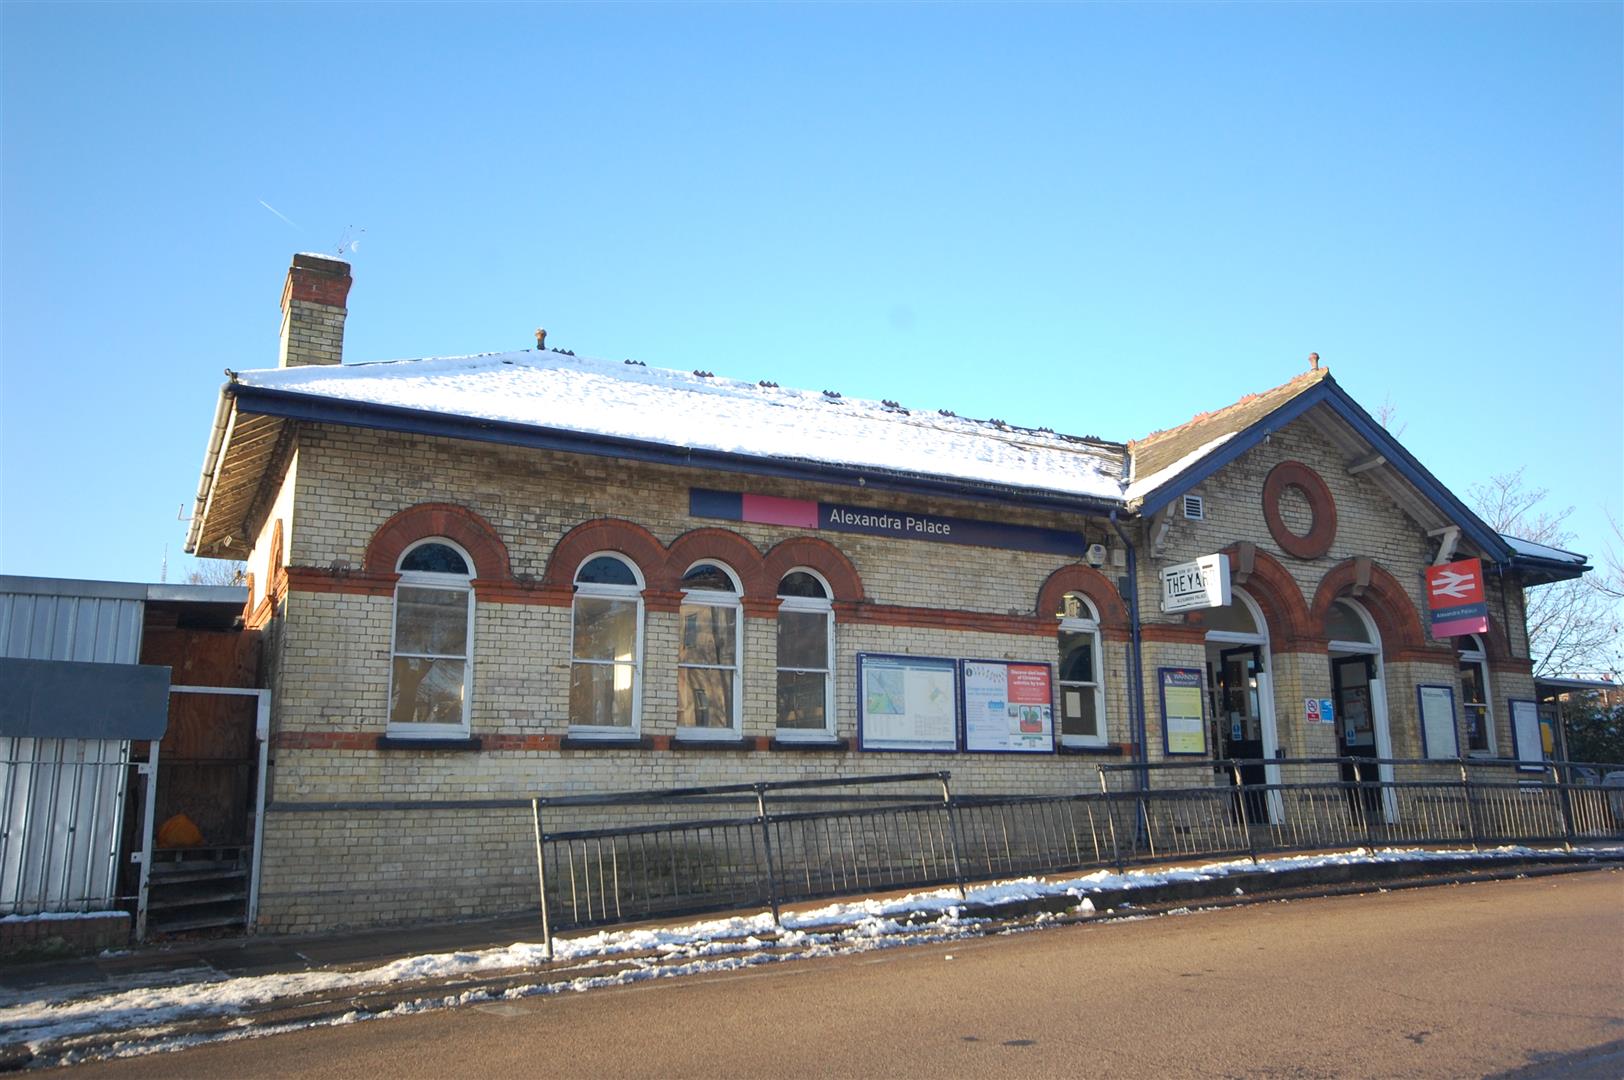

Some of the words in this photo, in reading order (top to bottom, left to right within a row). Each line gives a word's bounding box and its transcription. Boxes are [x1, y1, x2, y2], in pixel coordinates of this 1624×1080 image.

[830, 509, 901, 529] Alexandra
[906, 517, 951, 534] Palace
[1166, 576, 1185, 594] THE
